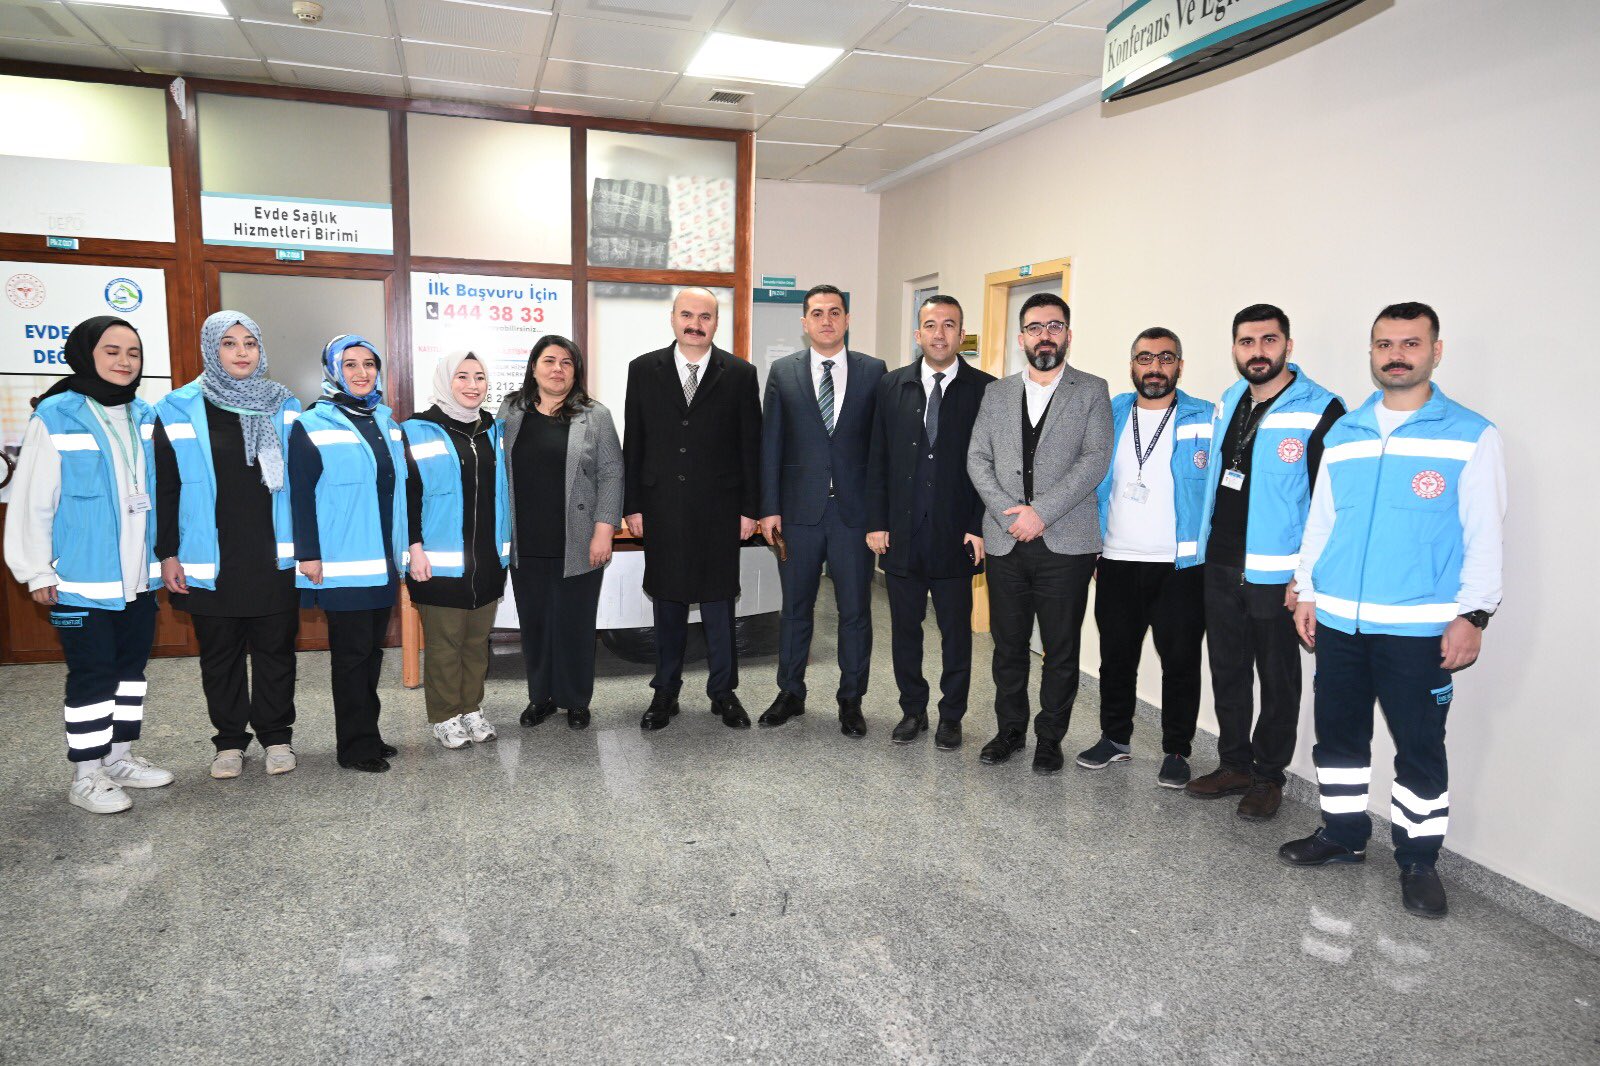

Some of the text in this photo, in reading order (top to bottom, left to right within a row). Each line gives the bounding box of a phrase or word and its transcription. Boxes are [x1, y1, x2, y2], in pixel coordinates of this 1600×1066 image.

[1107, 13, 1170, 72] Konferans
[1176, 0, 1196, 30] Ve
[254, 206, 338, 225] Evde Sağlık
[234, 222, 359, 243] Hizmetleri Birimi
[428, 278, 558, 303] İlk Başvuru İçin
[443, 303, 544, 323] 444 38 33
[25, 324, 70, 339] EVDE
[34, 345, 67, 365] DEĞ
[496, 381, 515, 391] 212
